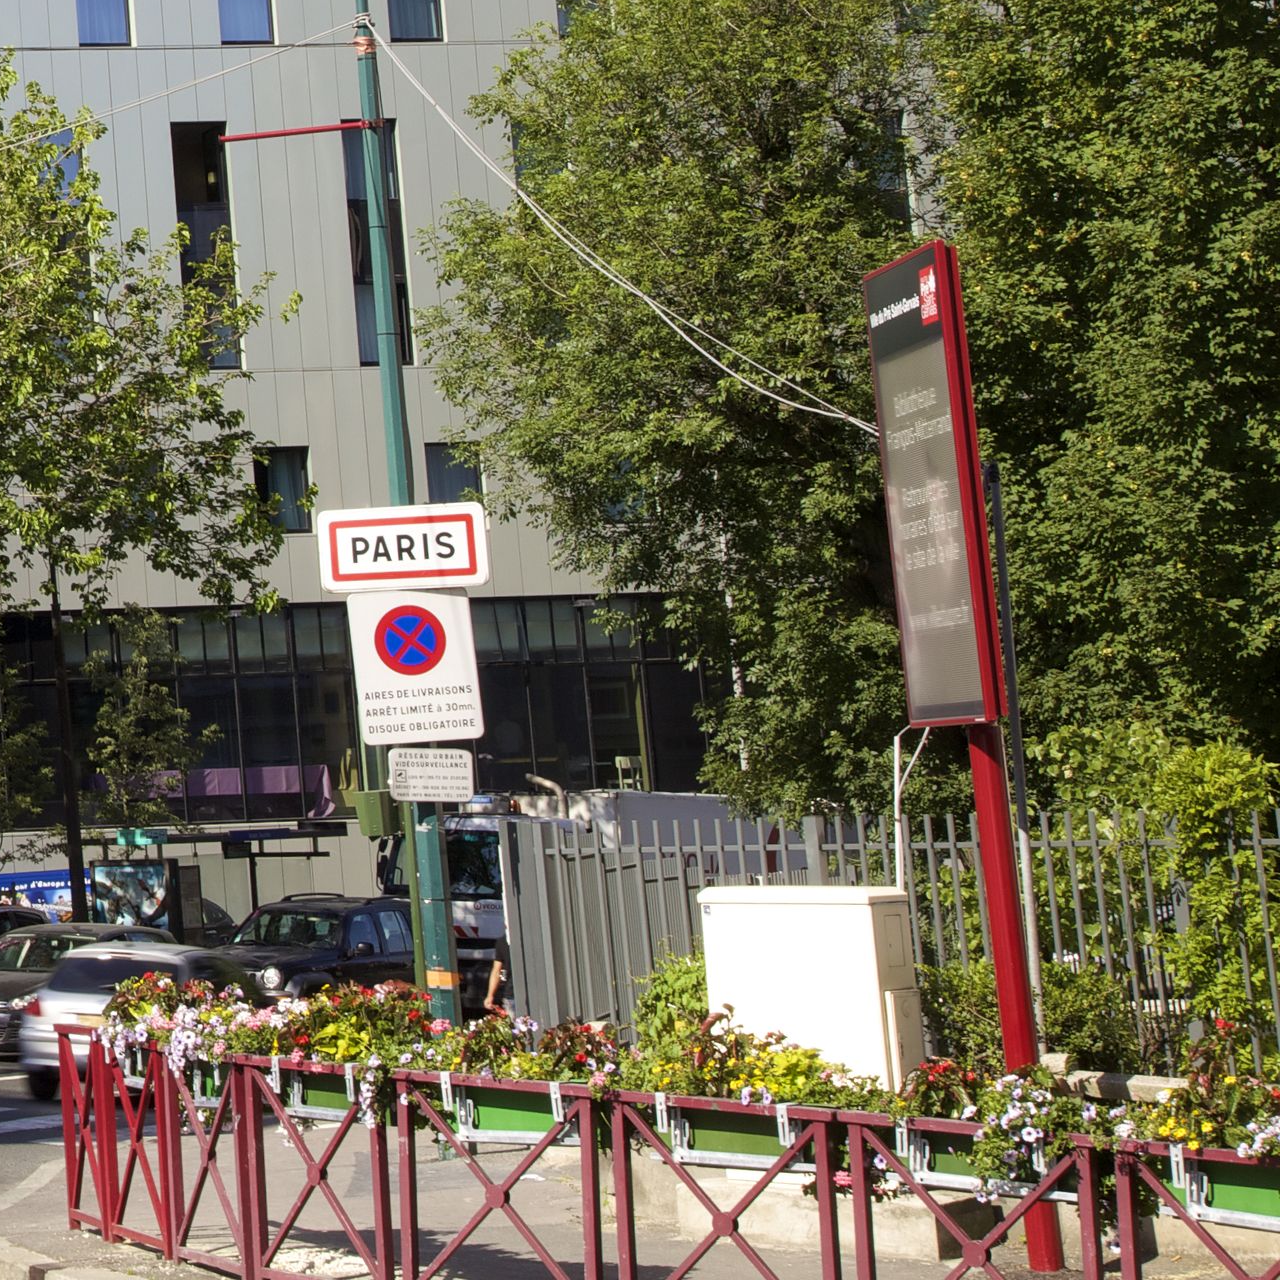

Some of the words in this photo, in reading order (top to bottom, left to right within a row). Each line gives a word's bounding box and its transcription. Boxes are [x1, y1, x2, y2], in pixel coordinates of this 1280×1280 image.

[351, 531, 456, 564] PARIS
[364, 690, 394, 701] AIRES
[396, 689, 409, 699] DE
[411, 684, 473, 698] LIVRAISONS
[365, 705, 398, 718] ARRÊT
[400, 703, 434, 716] LIMITÉ
[368, 723, 406, 735] DISQUE
[409, 718, 476, 732] OBLIGATOIRE
